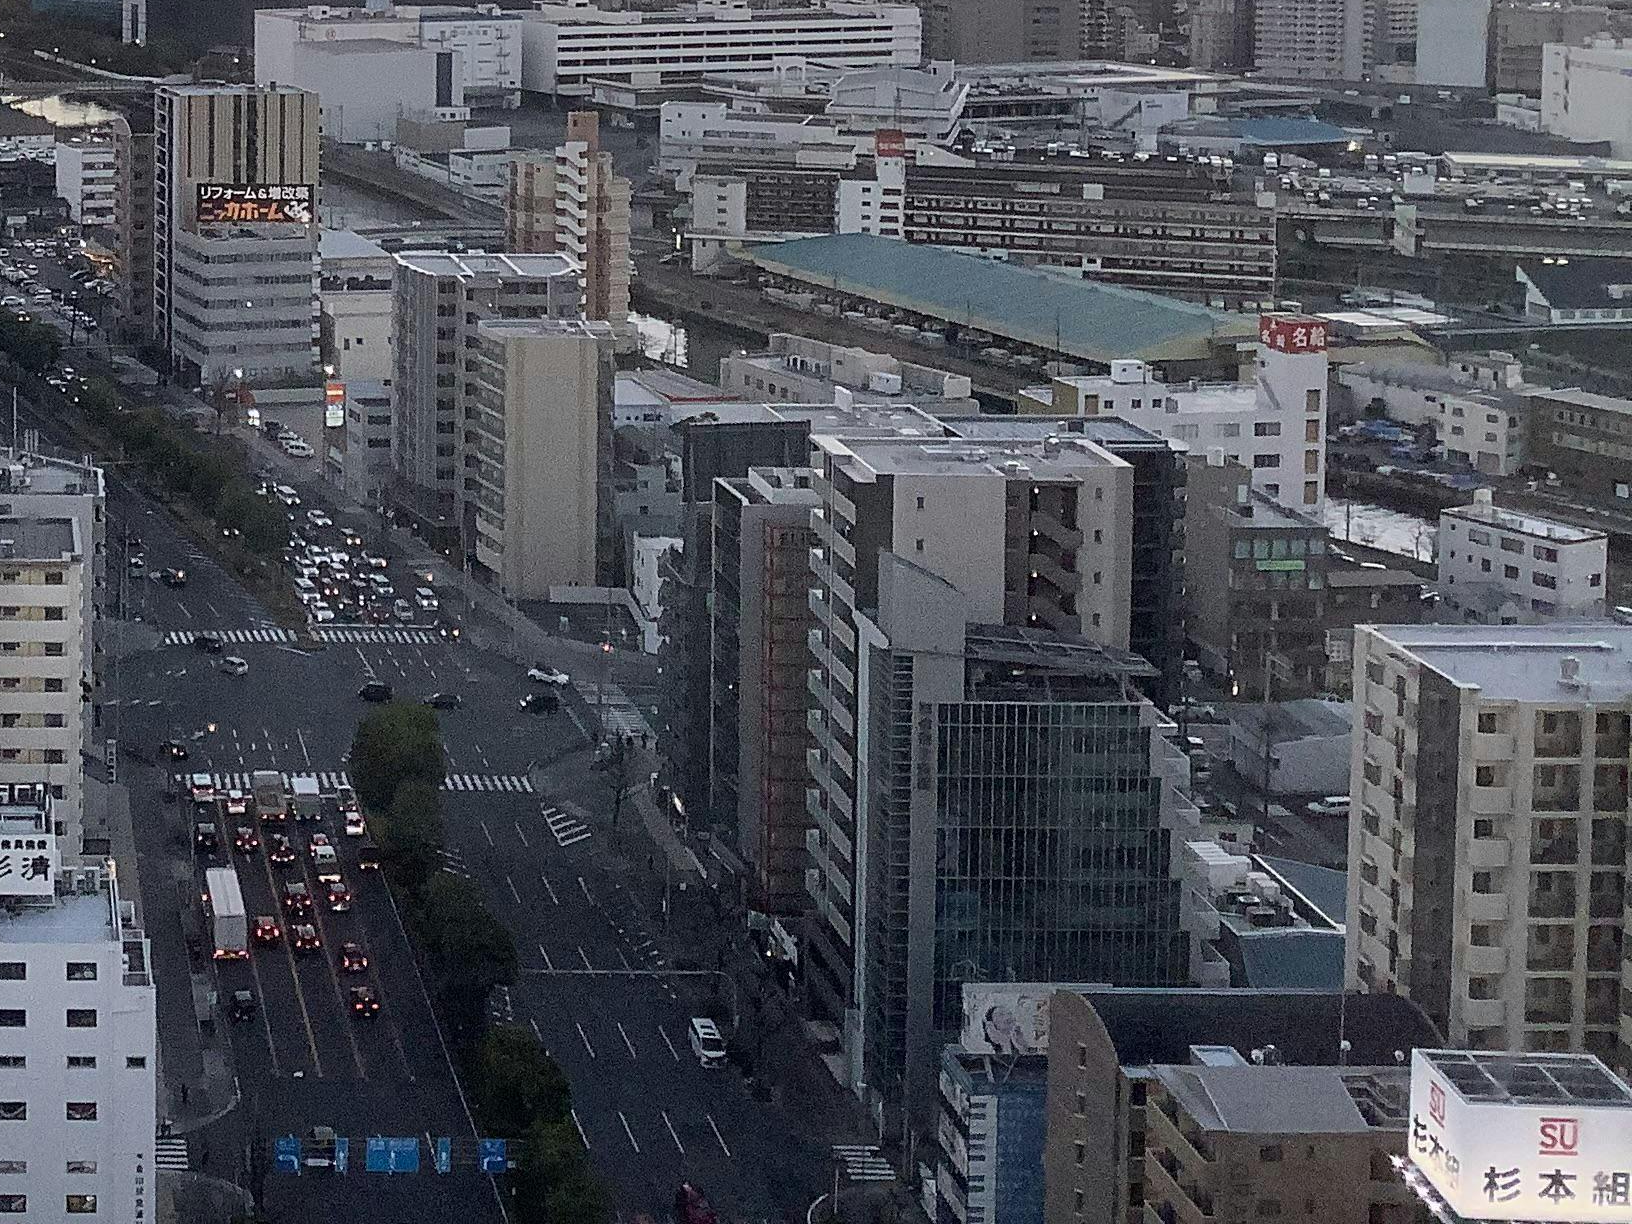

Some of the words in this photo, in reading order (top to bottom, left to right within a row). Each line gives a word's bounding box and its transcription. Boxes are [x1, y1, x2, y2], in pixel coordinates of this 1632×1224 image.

[200, 201, 284, 220] ニッカホーム
[1538, 1122, 1578, 1151] SU
[1483, 1166, 1631, 1207] 杉本組
